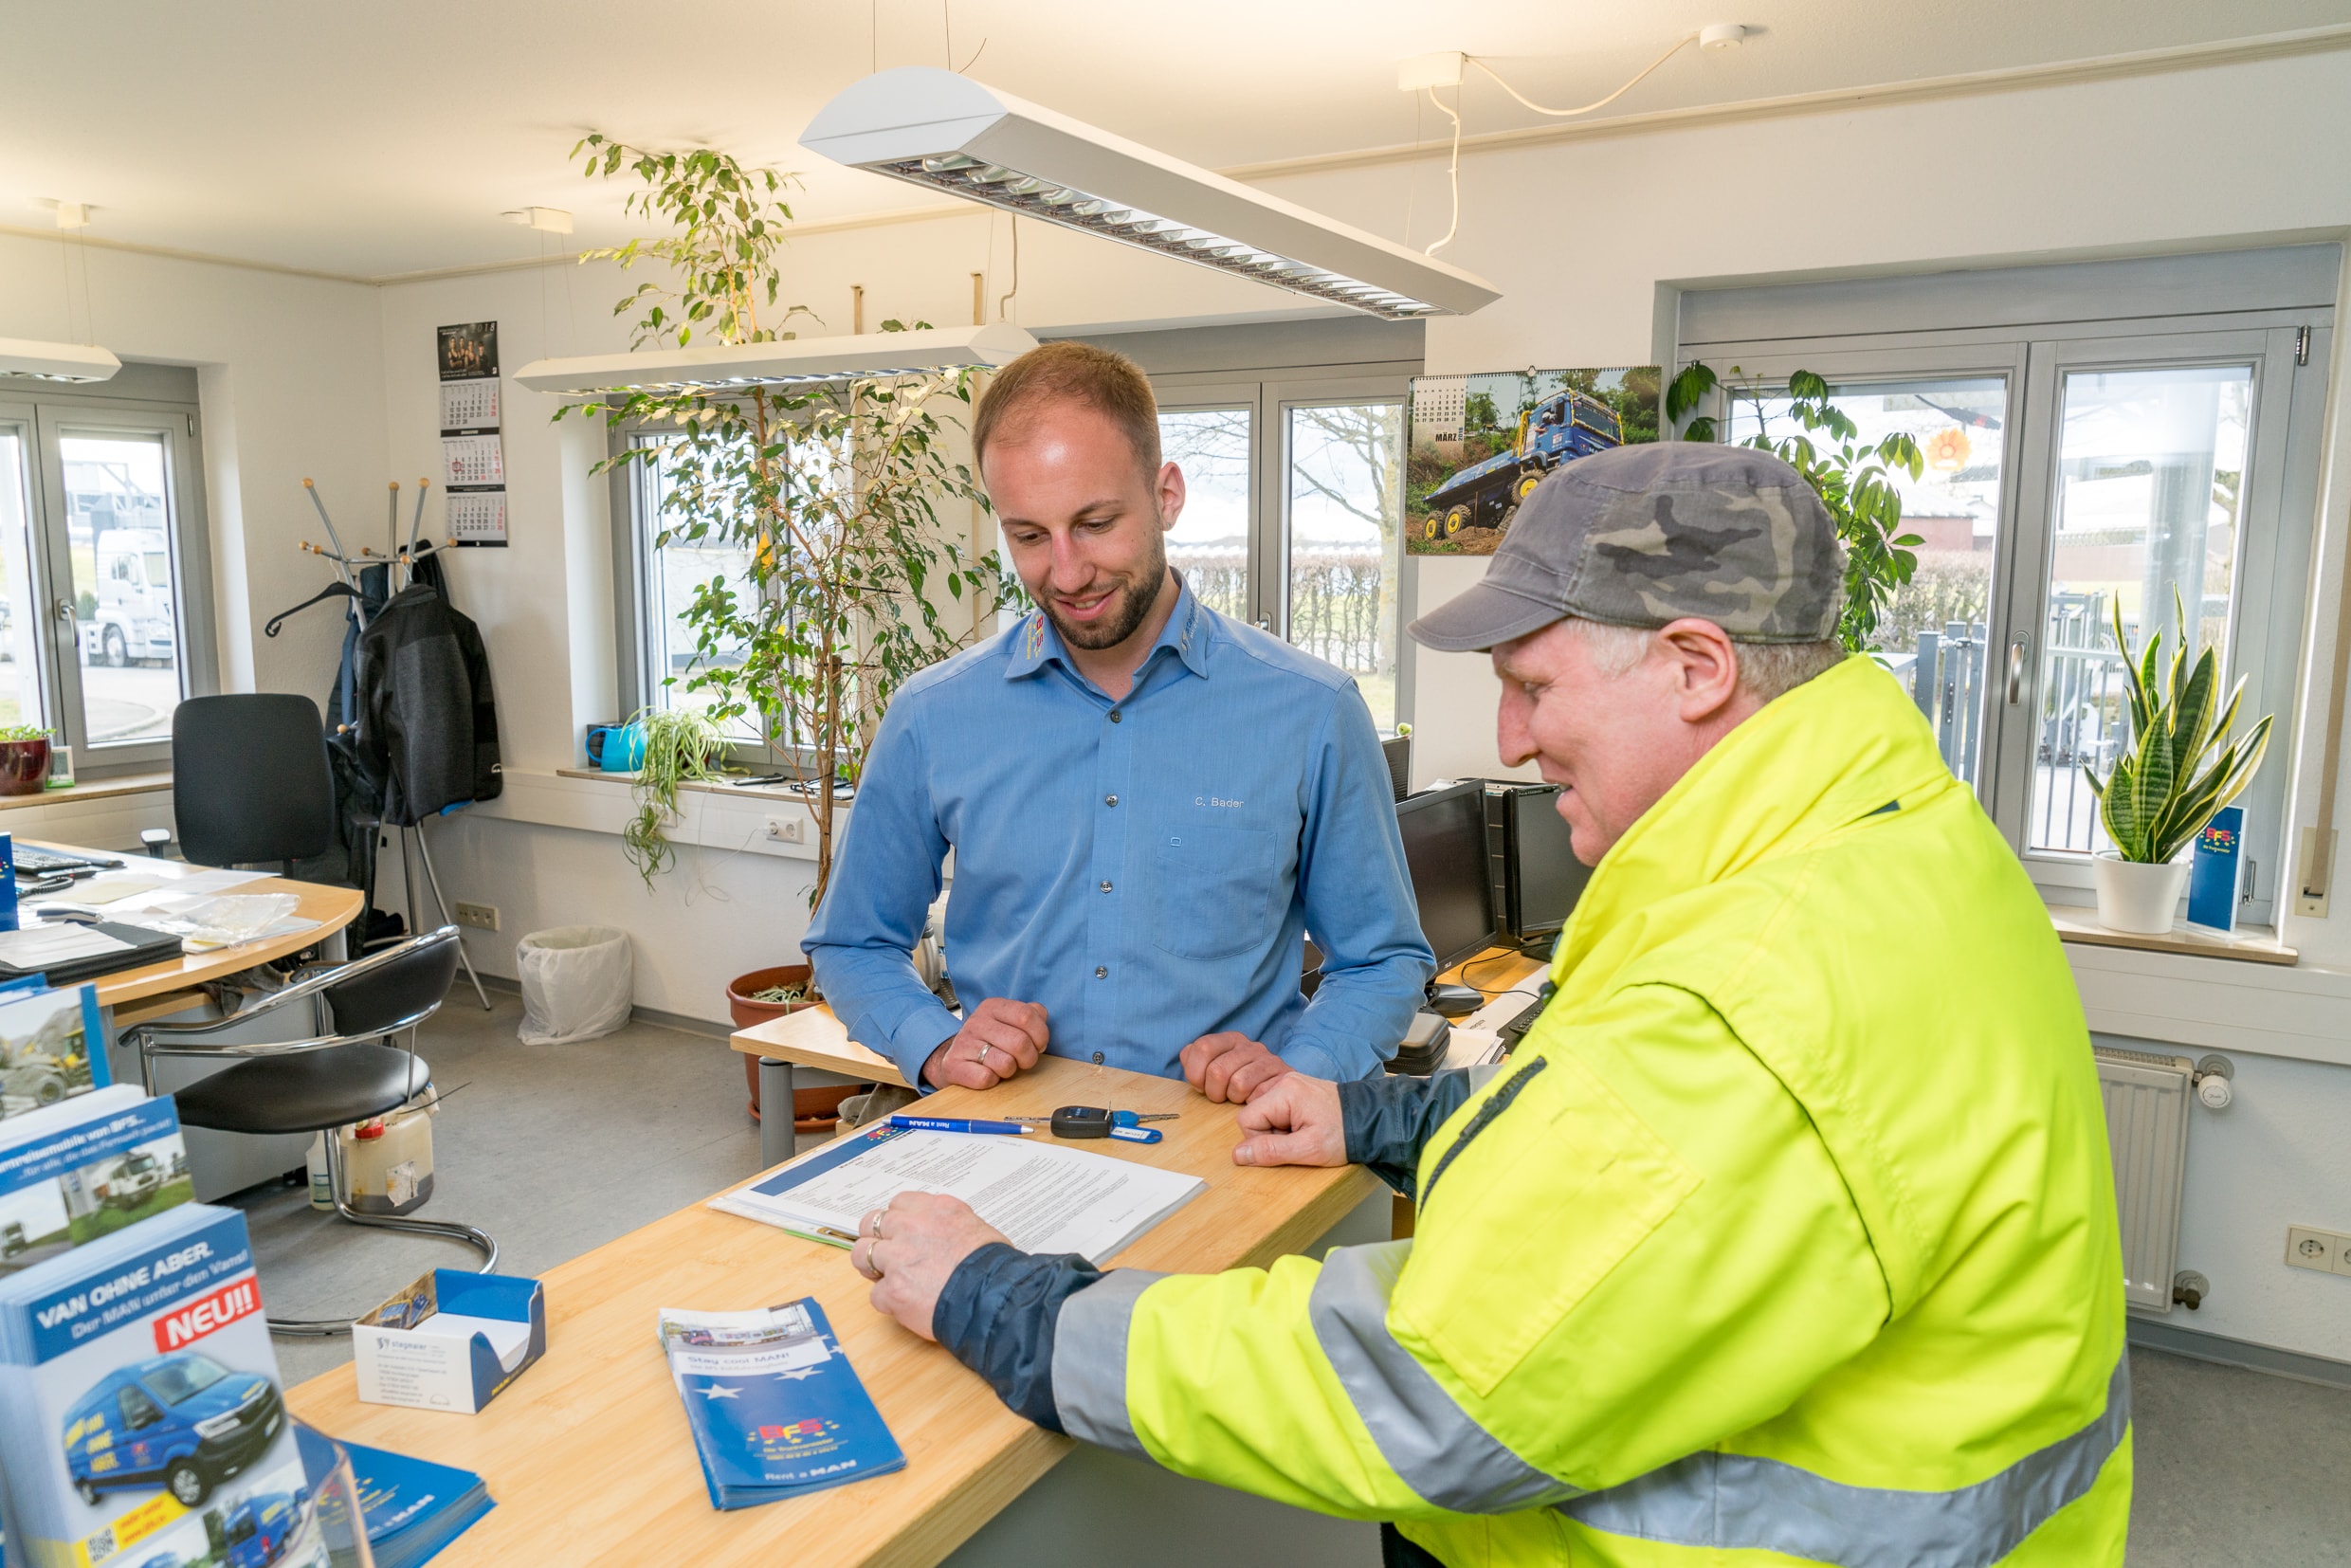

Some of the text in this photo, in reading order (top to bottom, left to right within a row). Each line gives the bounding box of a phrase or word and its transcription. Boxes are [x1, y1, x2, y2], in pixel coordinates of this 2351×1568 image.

[1435, 432, 1457, 442] MÄRZ
[1195, 796, 1244, 808] C. Bader
[2206, 827, 2231, 841] BFS
[37, 1241, 214, 1329] VAN OHNE ABER.
[71, 1317, 101, 1340] Der
[103, 1300, 142, 1325] MAN
[143, 1282, 181, 1308] unter
[182, 1269, 209, 1289] den
[165, 1283, 254, 1347] NEU!!
[688, 1357, 719, 1365] Stay
[754, 1352, 789, 1362] MAN!
[759, 1418, 822, 1440] BFS
[765, 1472, 795, 1481] Rent
[810, 1459, 857, 1477] MAN
